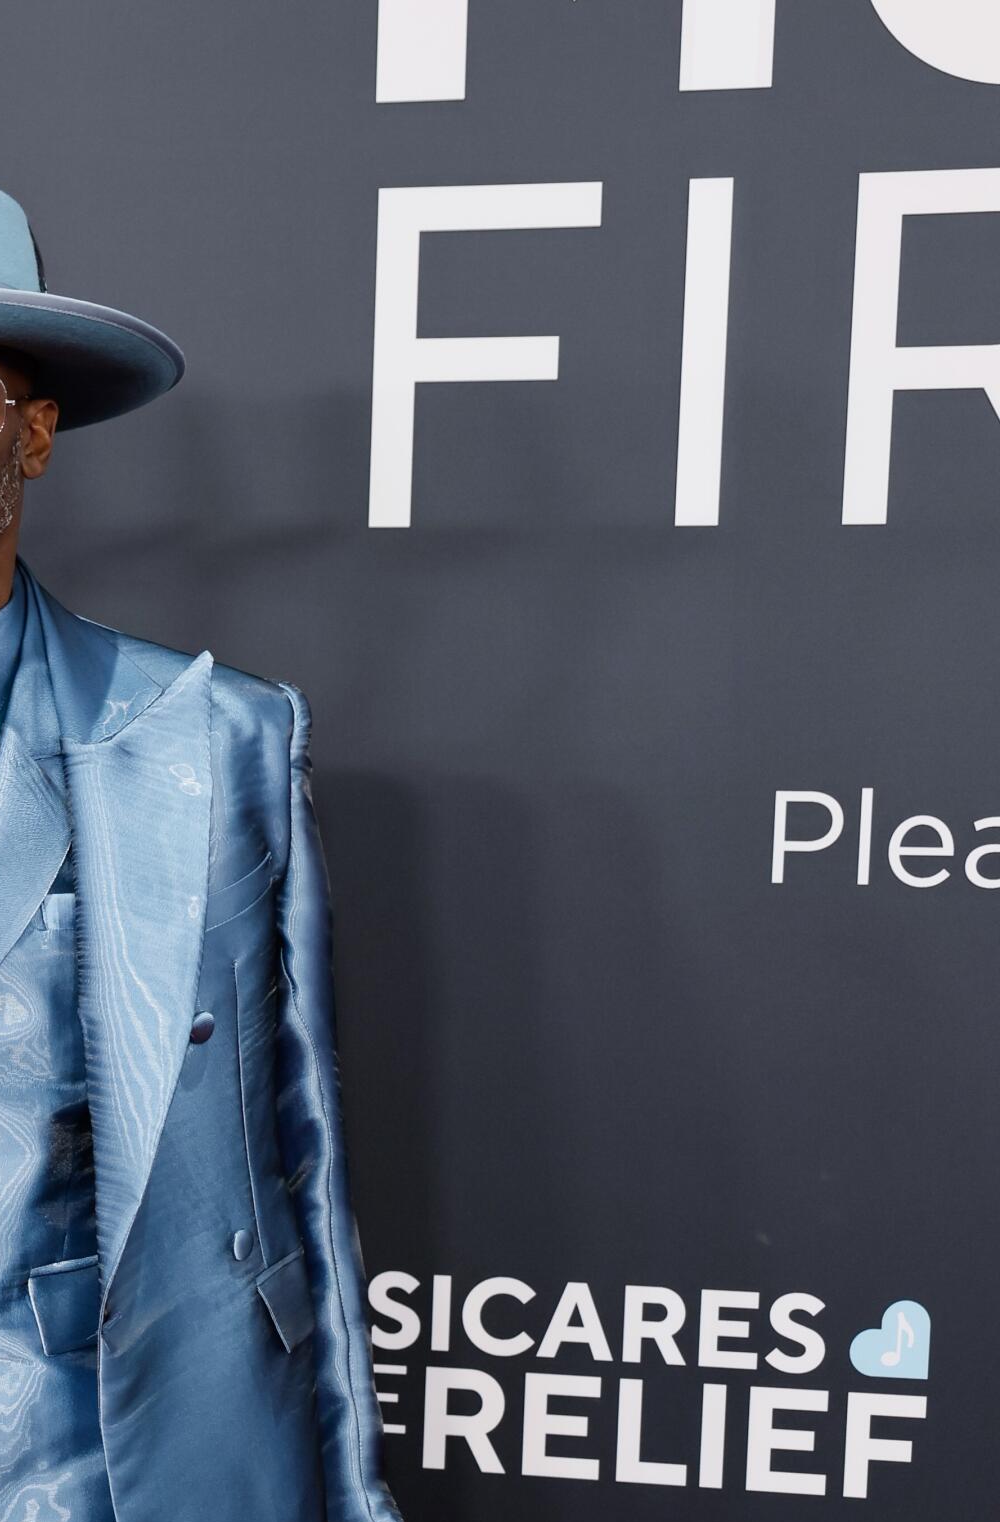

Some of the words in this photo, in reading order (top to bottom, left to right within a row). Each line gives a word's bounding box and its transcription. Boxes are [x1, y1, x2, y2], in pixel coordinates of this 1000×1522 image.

[368, 167, 1000, 528] FIR
[771, 787, 1000, 889] Plea
[367, 1270, 827, 1374] SICARES
[422, 1366, 928, 1499] RELIEF
